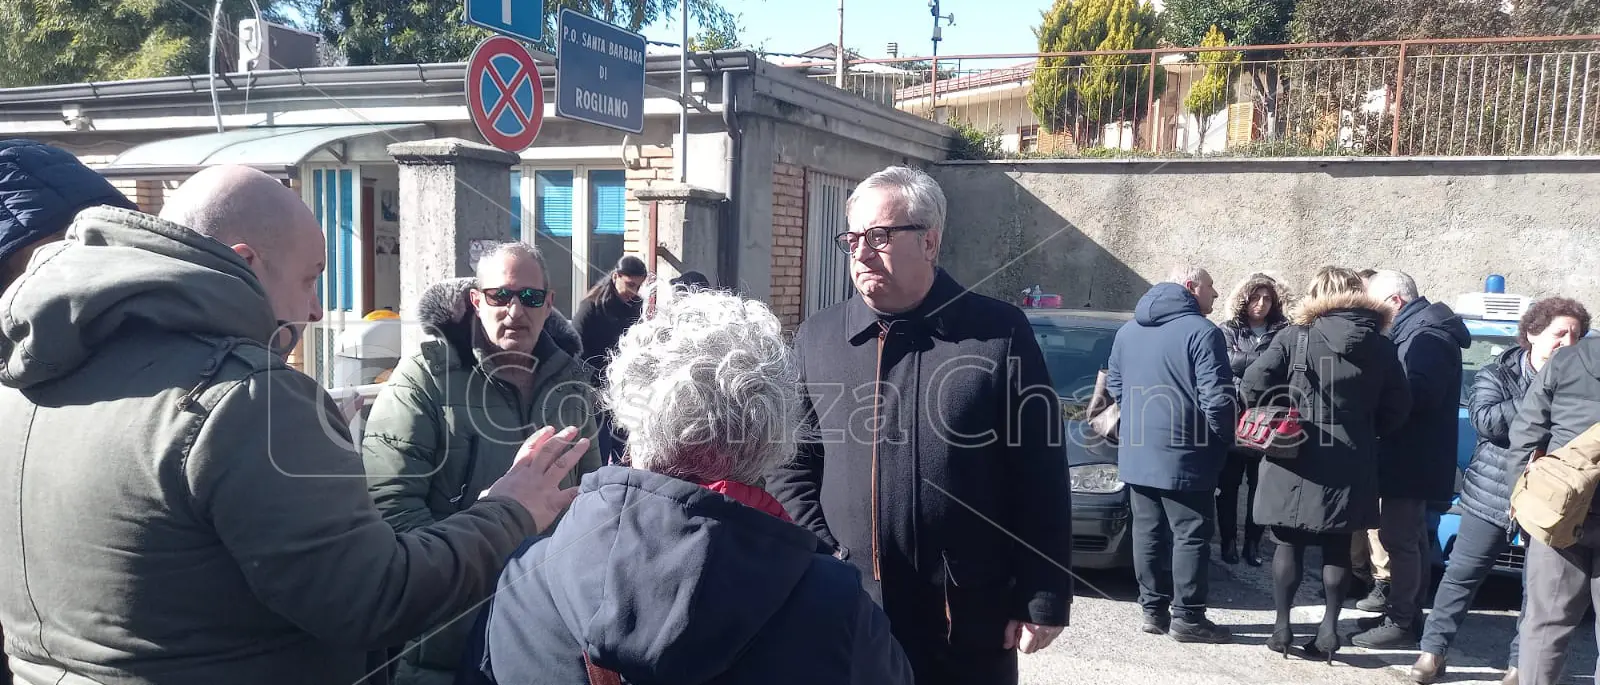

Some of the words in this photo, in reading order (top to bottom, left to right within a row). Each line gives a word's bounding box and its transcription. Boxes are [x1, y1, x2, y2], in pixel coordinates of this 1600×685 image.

[563, 25, 578, 44] P.O.
[582, 32, 606, 53] SANTA
[609, 42, 642, 65] BARBARA
[599, 65, 608, 80] DI
[575, 87, 628, 119] ROGLIANO
